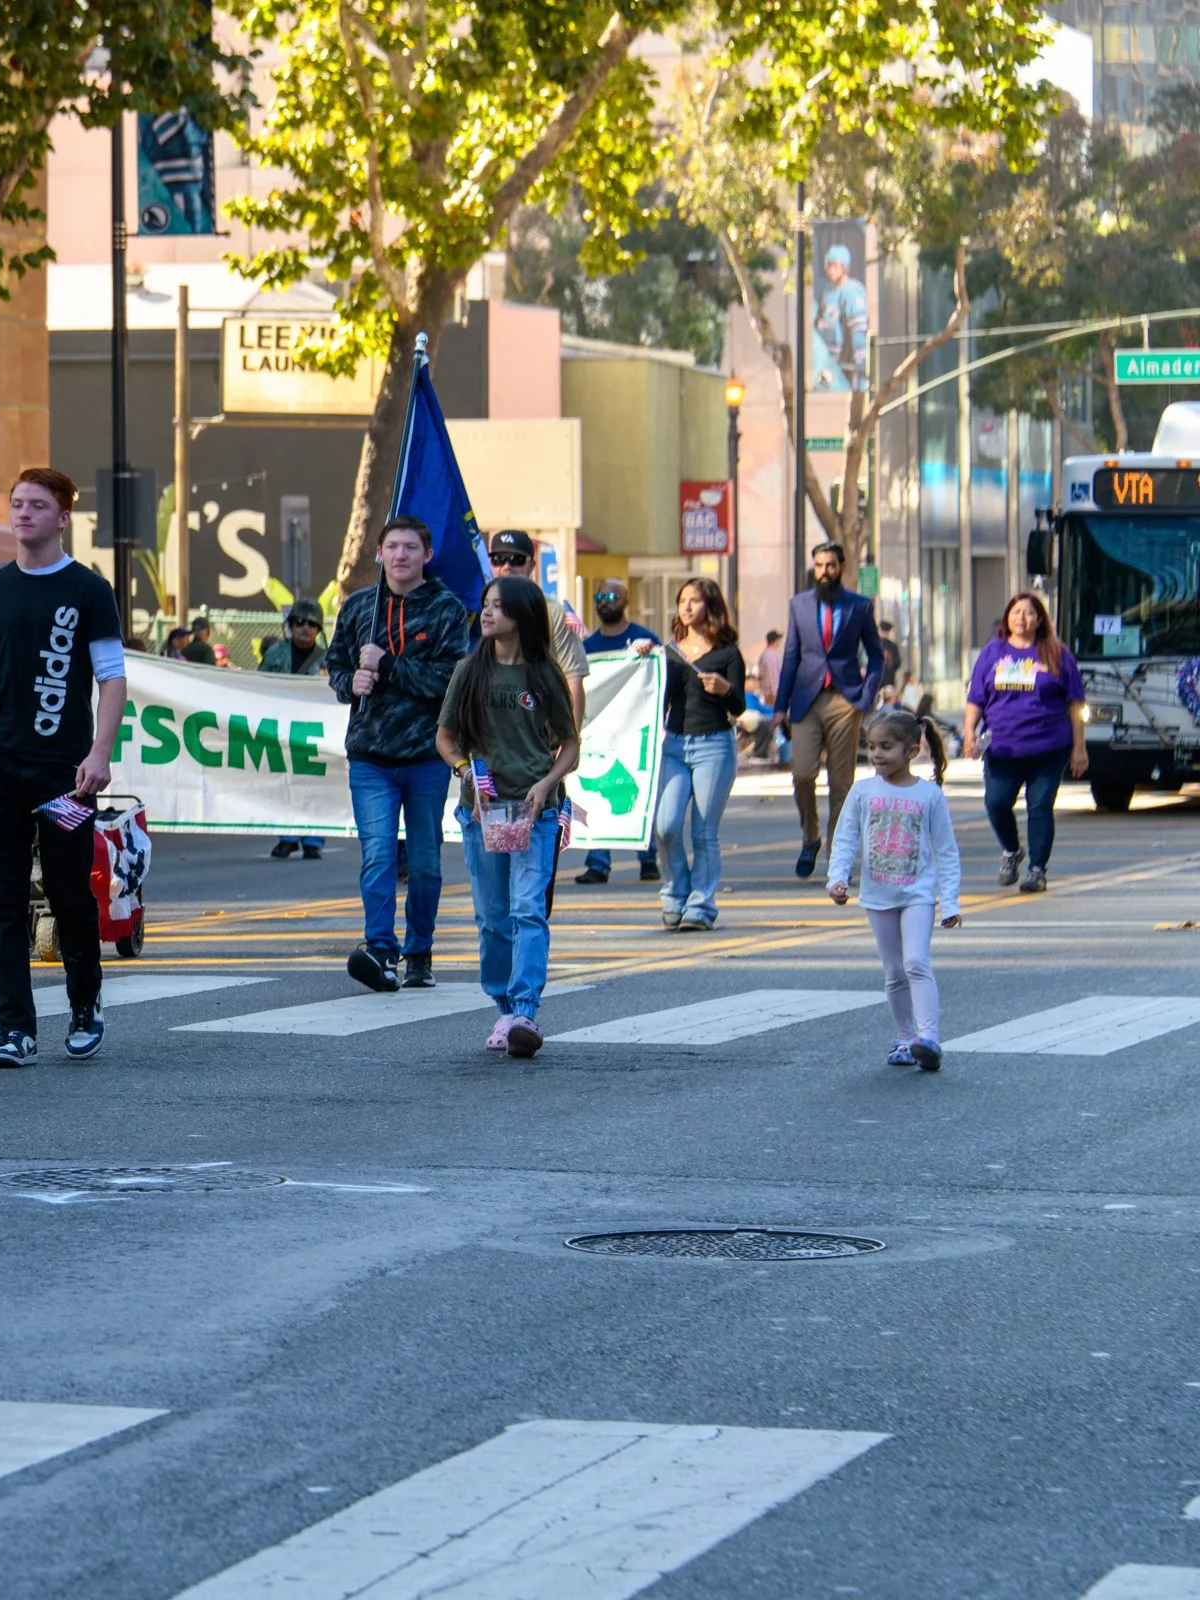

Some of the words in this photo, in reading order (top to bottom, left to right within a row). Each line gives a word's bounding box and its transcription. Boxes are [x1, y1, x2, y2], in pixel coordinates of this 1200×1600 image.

[240, 325, 291, 349] LEE
[1113, 471, 1153, 505] VTA
[34, 606, 80, 736] adidas
[868, 796, 925, 814] QUEEN
